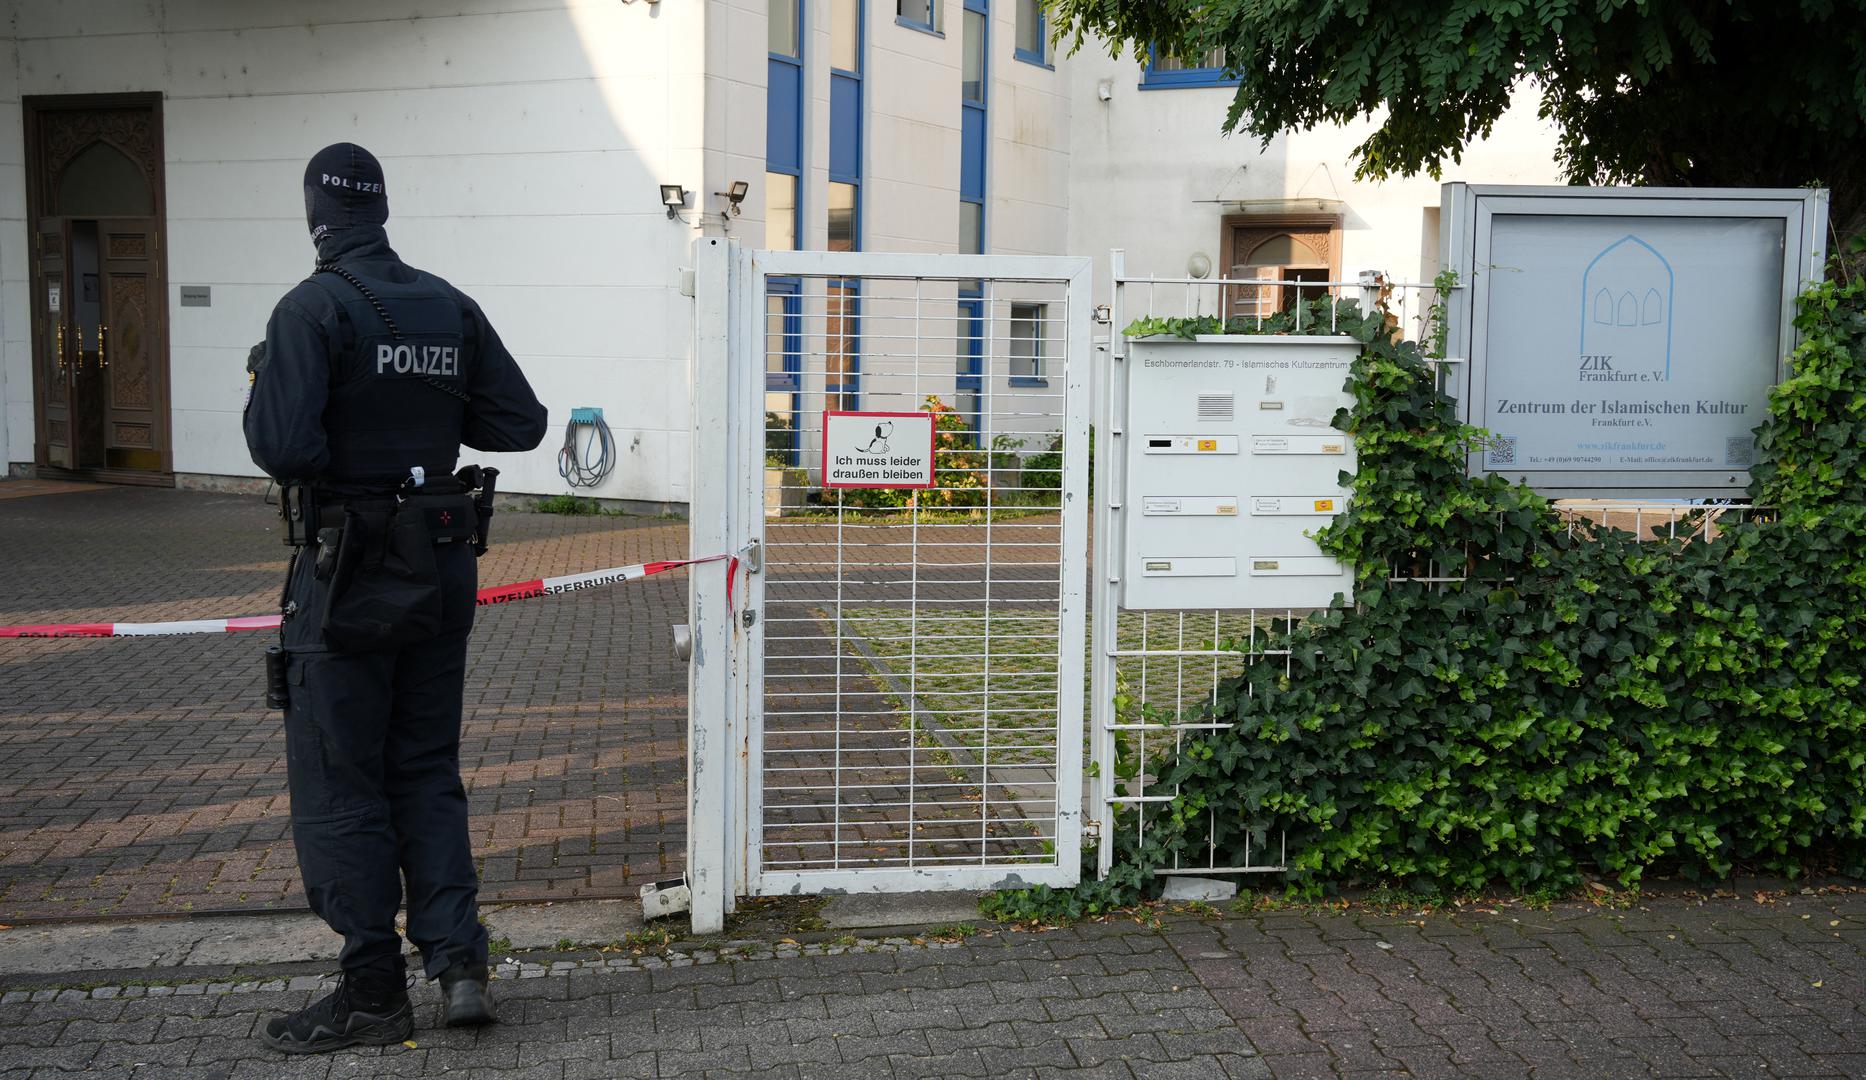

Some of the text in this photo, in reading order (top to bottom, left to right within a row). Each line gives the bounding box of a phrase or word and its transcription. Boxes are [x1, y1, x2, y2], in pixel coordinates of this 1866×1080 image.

[322, 173, 382, 194] POLIZEI
[377, 344, 459, 376] POLIZEI
[1223, 359, 1234, 368] 79
[1291, 360, 1348, 369] Kulturzentrum
[1579, 355, 1613, 371] ZIK
[1579, 371, 1664, 382] Frankfurt e. V.
[1497, 400, 1749, 415] Zentrum der Islamischen Kultur
[1591, 418, 1653, 427] Frankfurt e.V.
[1576, 441, 1666, 450] www.zikfrankfurt.de
[835, 456, 921, 466] Ich muss leider
[832, 469, 923, 479] draußen bleiben
